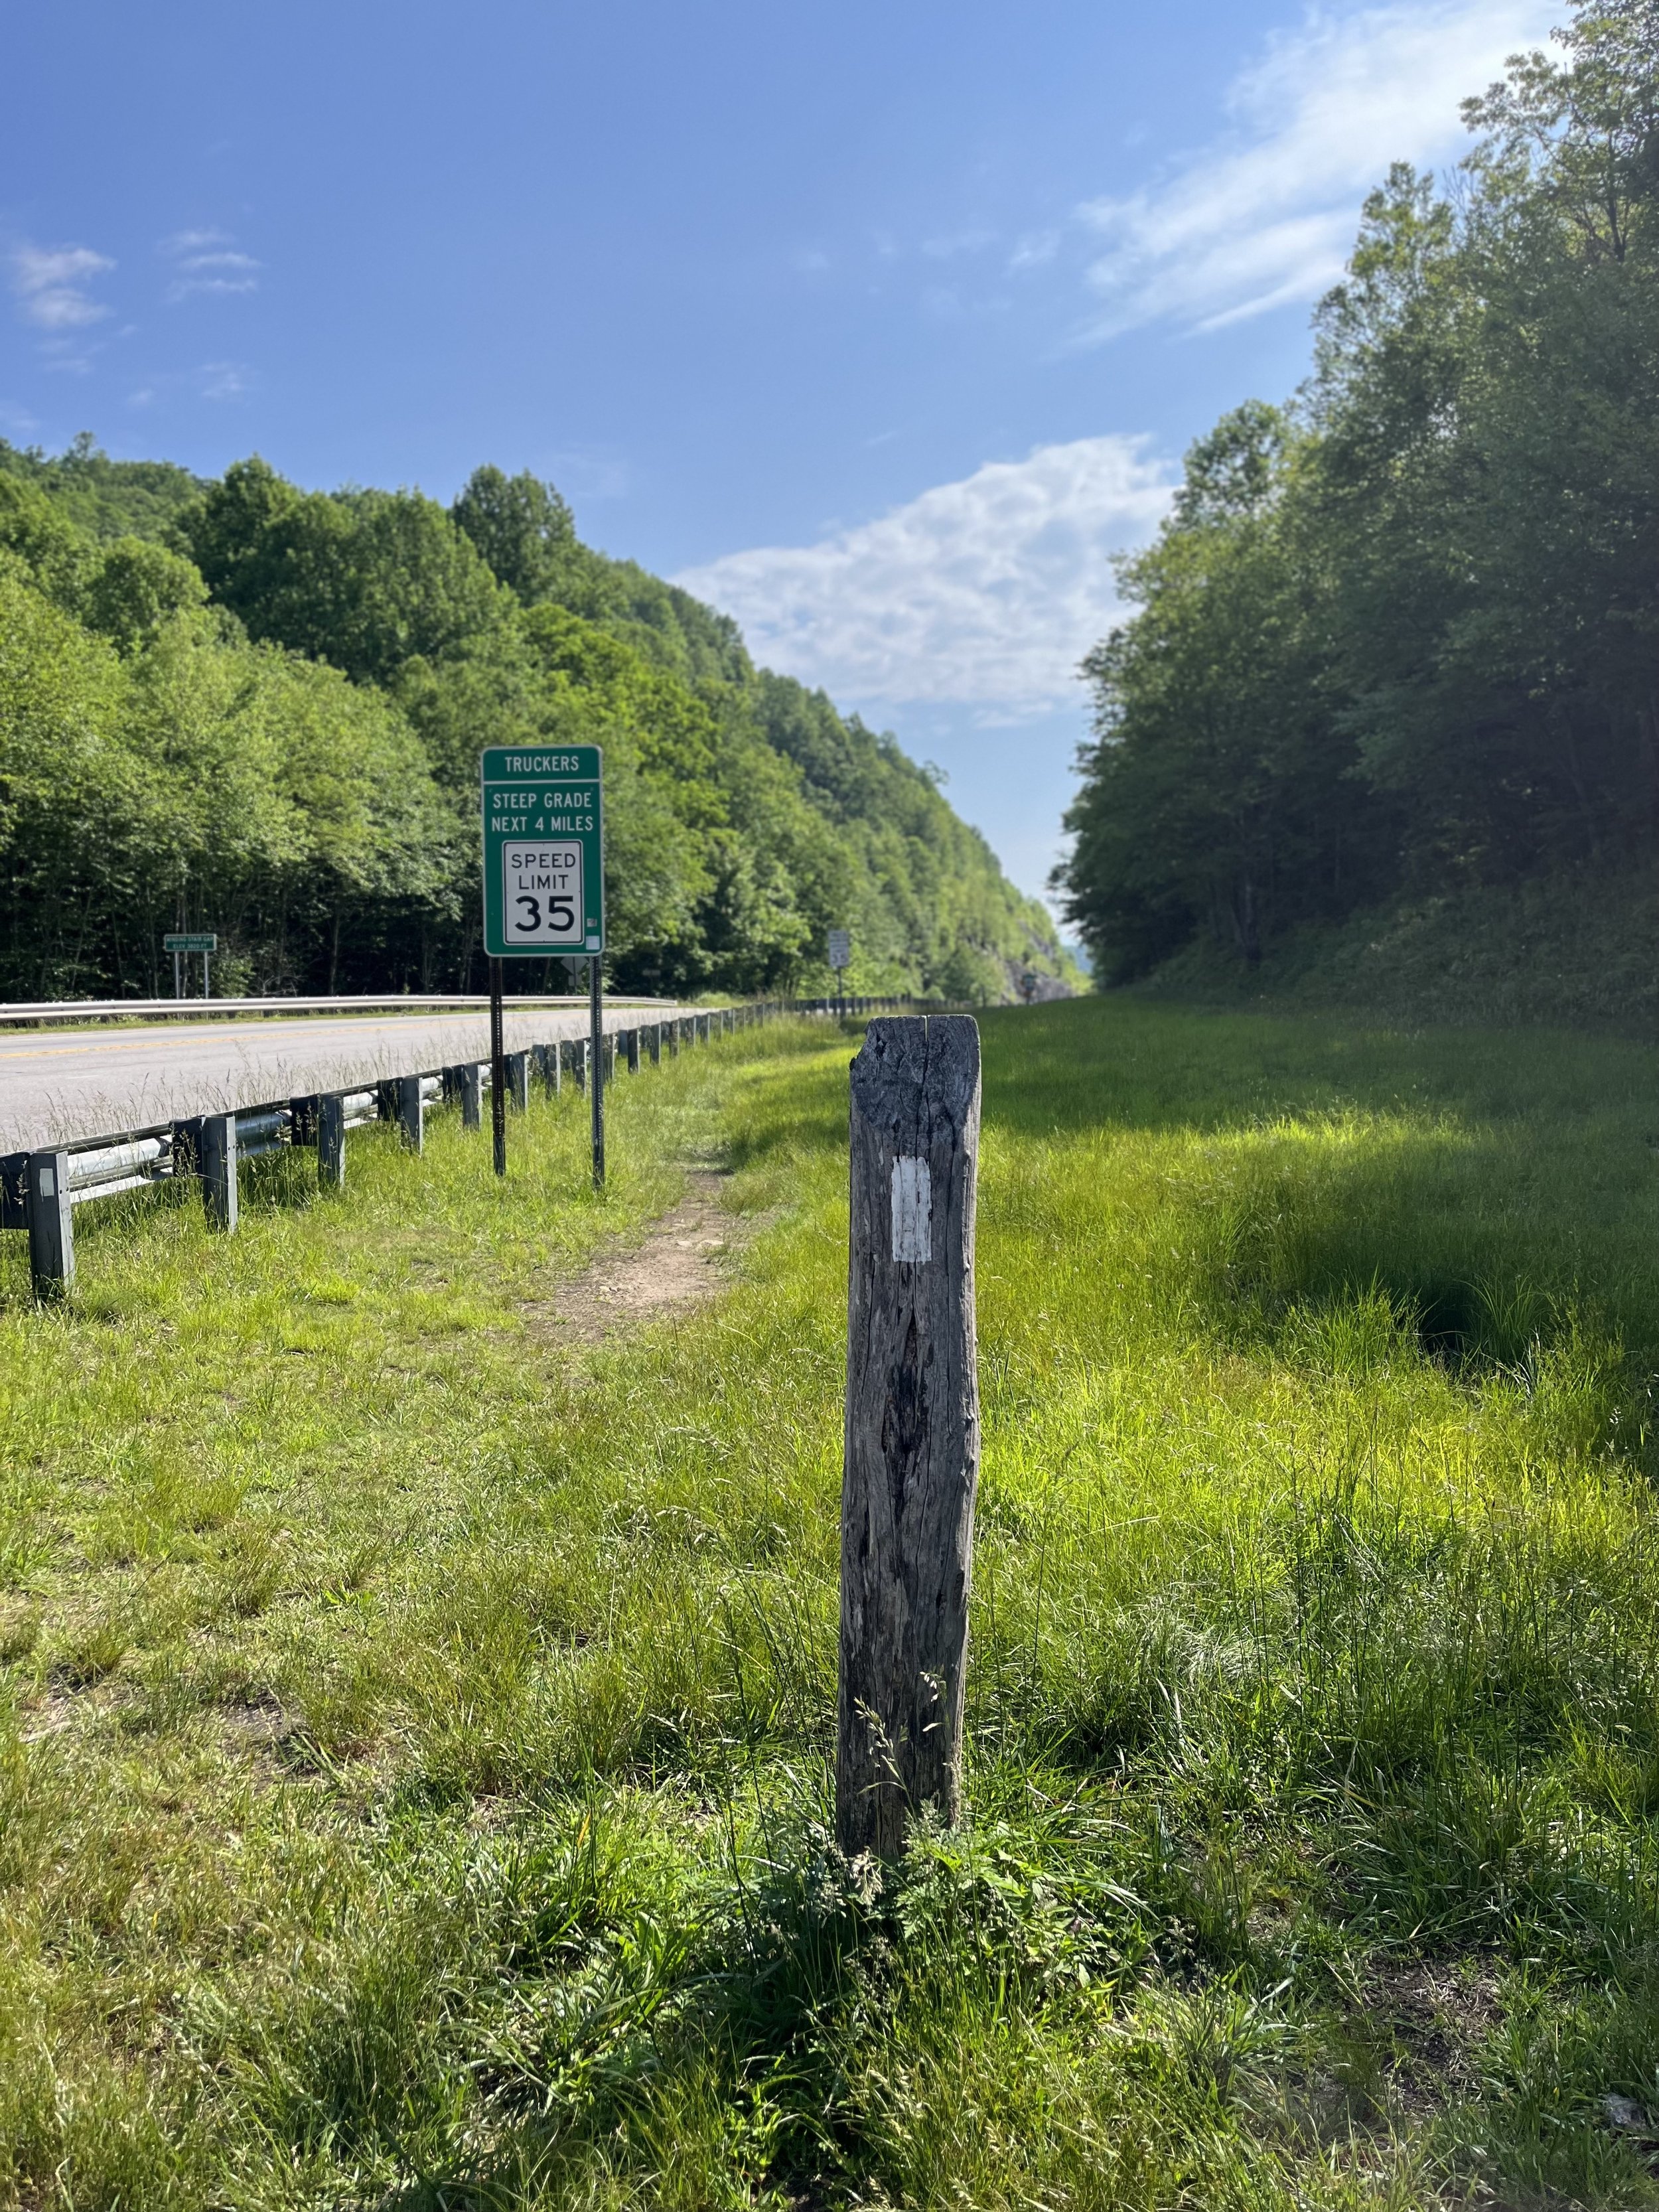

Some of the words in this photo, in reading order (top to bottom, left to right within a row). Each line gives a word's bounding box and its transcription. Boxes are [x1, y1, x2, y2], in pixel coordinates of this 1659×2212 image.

[505, 755, 579, 772] TRUCKERS
[493, 793, 536, 808] STEEP
[544, 792, 592, 808] GRADE
[492, 817, 527, 832] NEXT
[535, 817, 544, 831] 4
[551, 816, 593, 831] MILES
[511, 853, 576, 869] SPEED
[518, 874, 569, 890] LIMIT
[514, 895, 575, 932] 35
